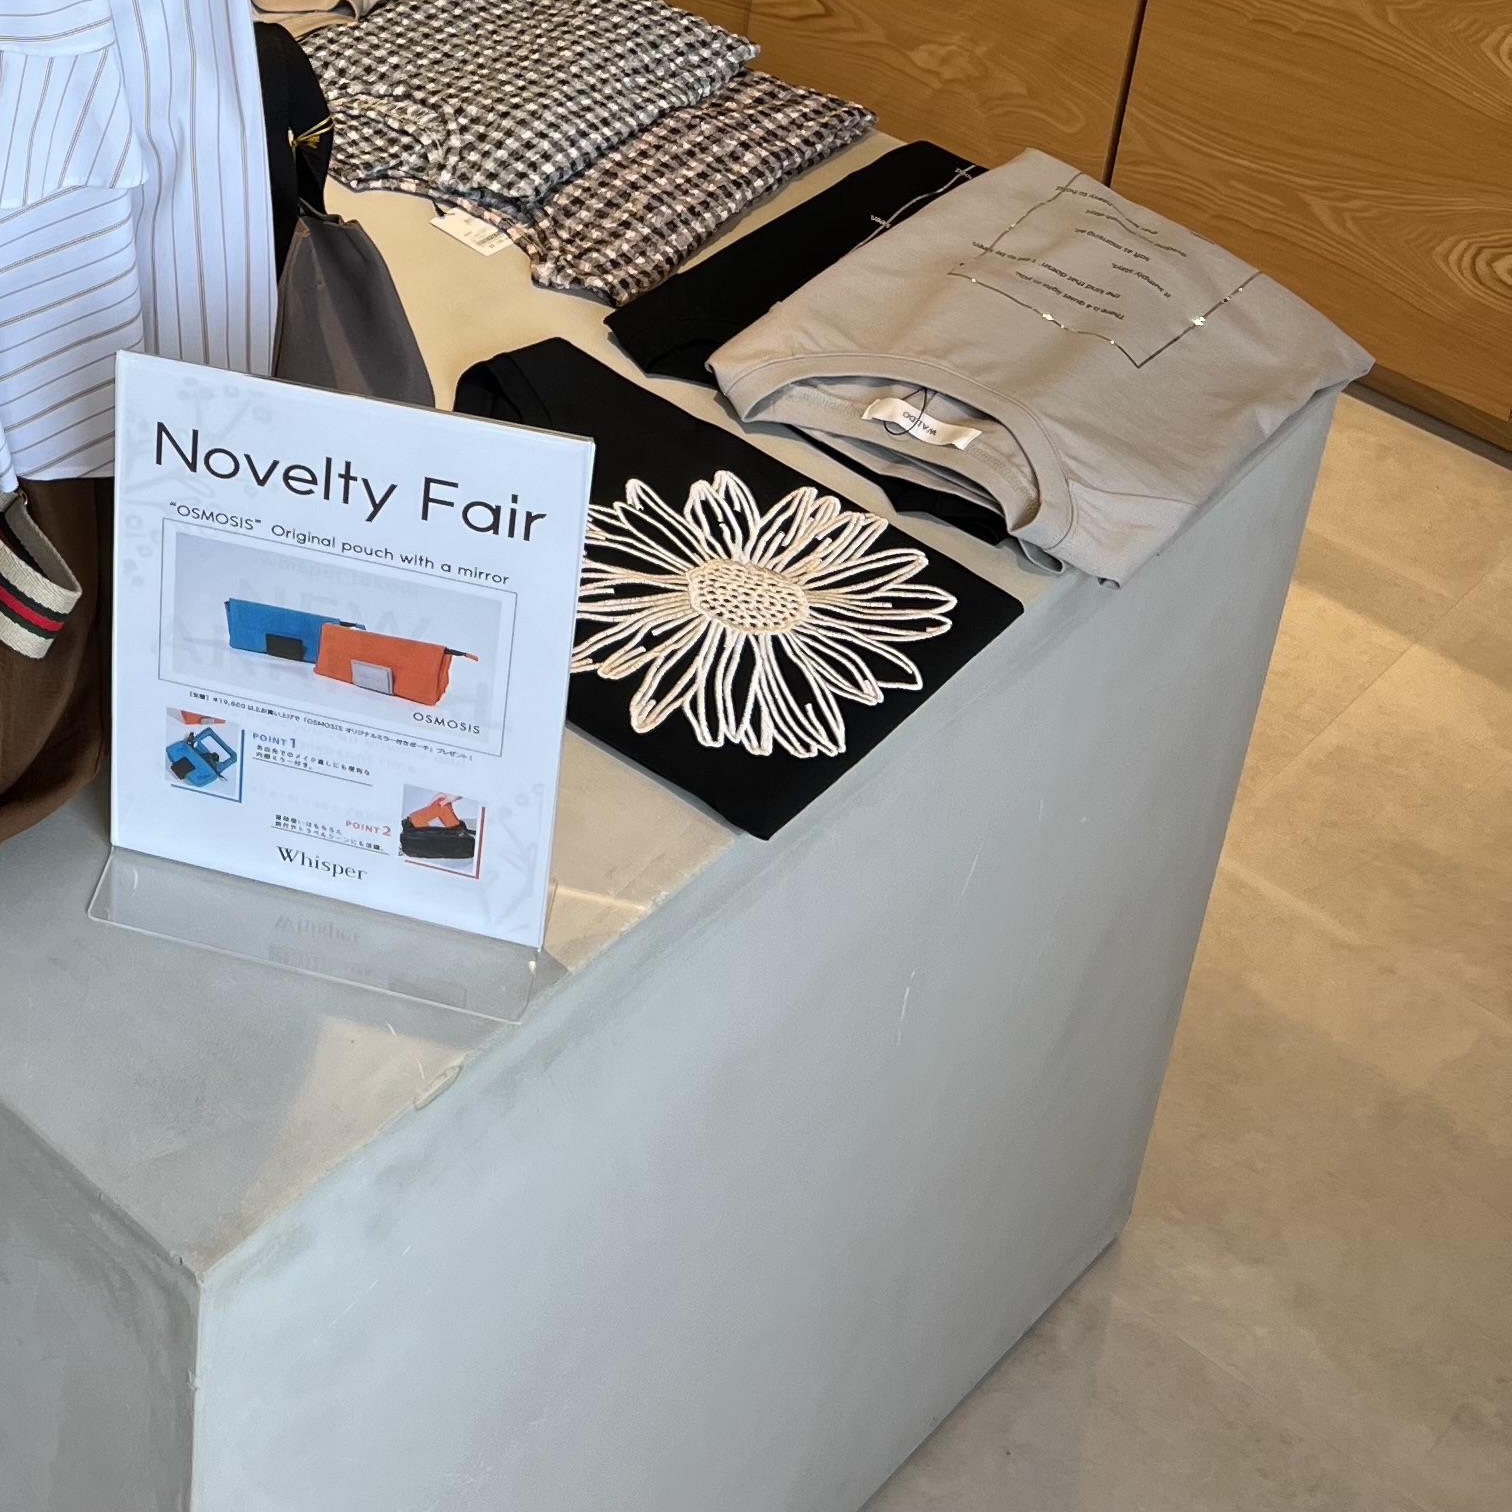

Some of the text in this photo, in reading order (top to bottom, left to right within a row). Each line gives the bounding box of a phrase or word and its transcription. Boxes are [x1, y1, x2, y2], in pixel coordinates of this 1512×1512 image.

[902, 411, 937, 436] WALDO
[155, 421, 548, 541] Novelty Fair
[271, 524, 336, 548] Original
[341, 541, 394, 561] pouch
[399, 554, 435, 570] with
[440, 562, 452, 573] a
[457, 566, 510, 585] mirror
[412, 712, 481, 734] OSMOSIS
[252, 732, 297, 749] POINT 1
[345, 820, 392, 837] POINT 2
[276, 845, 368, 881] Whisper
